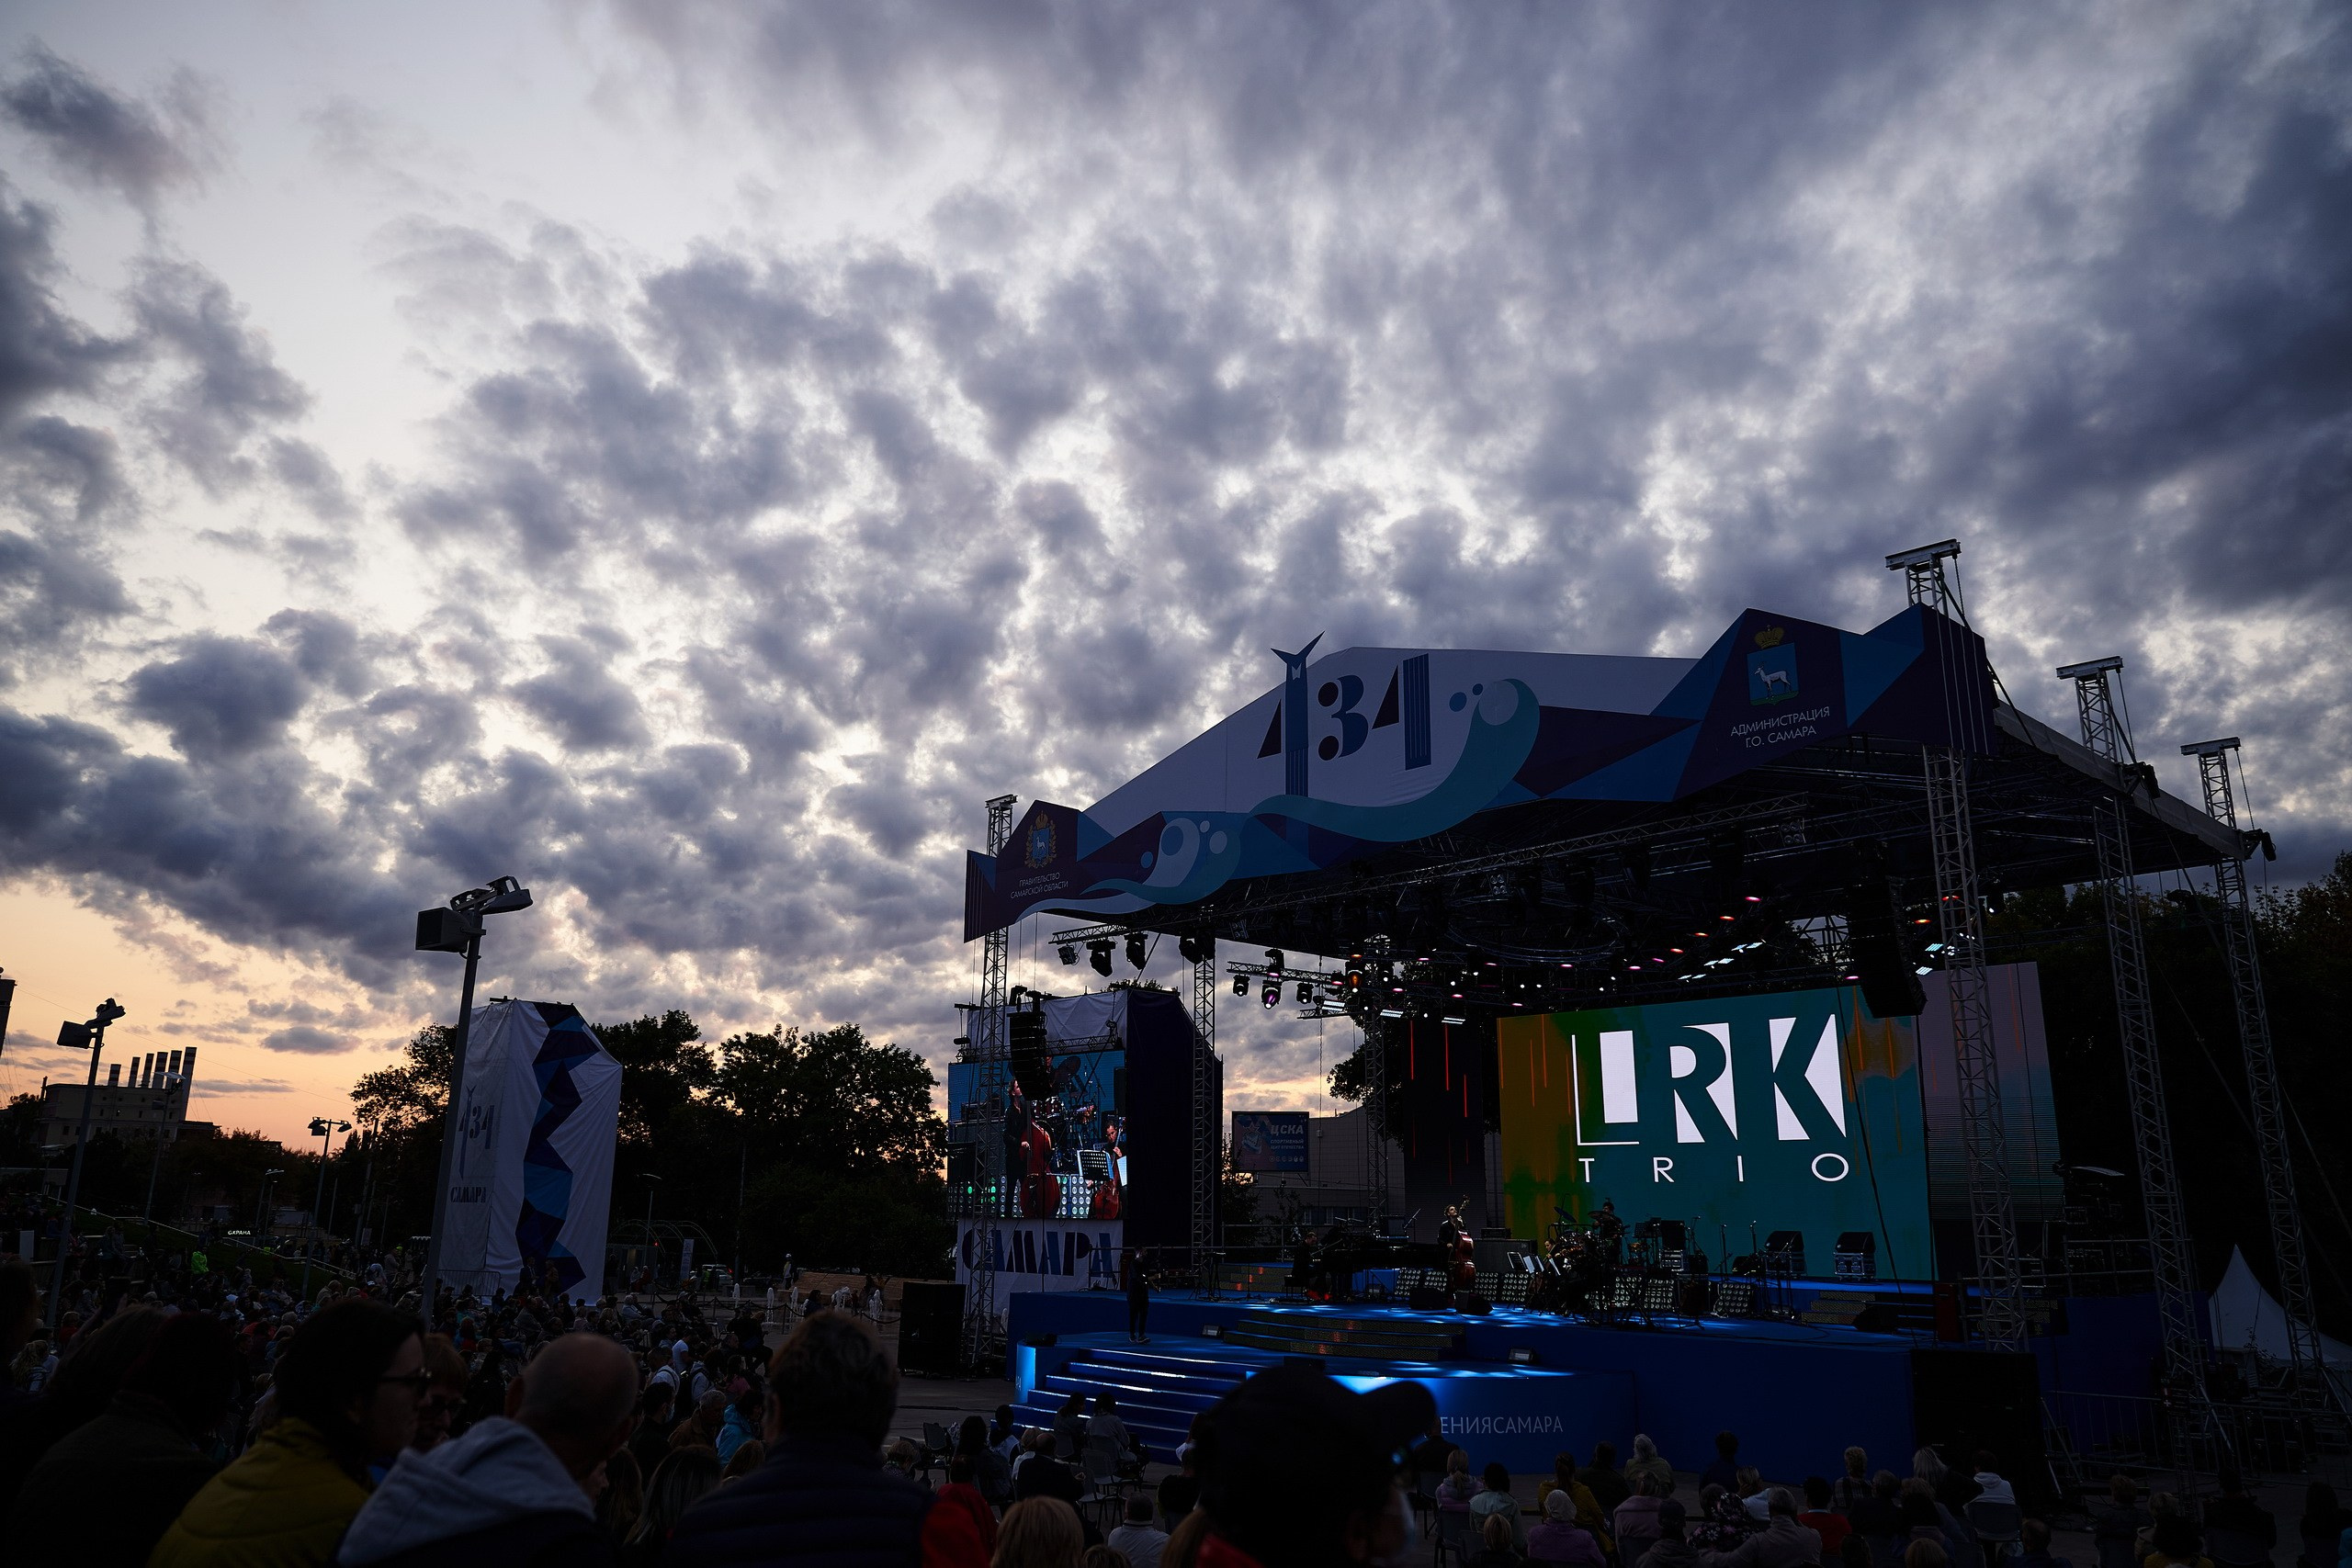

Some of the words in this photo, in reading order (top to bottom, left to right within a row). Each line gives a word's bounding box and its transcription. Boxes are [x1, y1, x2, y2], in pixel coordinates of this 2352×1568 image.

[1730, 705, 1830, 737] АДМИНИСТРАЦИЯ
[1746, 736, 1765, 749] Г.О.
[1767, 726, 1816, 744] САМАРА
[1010, 885, 1044, 899] САМАРСКОЙ
[1043, 880, 1069, 893] ОБЛАСТИ
[1019, 872, 1060, 887] ПРАВИТЕЛЬСТВО
[1571, 1013, 1847, 1146] LRK
[1270, 1124, 1304, 1136] ЦСКА
[1578, 1153, 1849, 1183] TRIO
[450, 1187, 486, 1203] САМАРА
